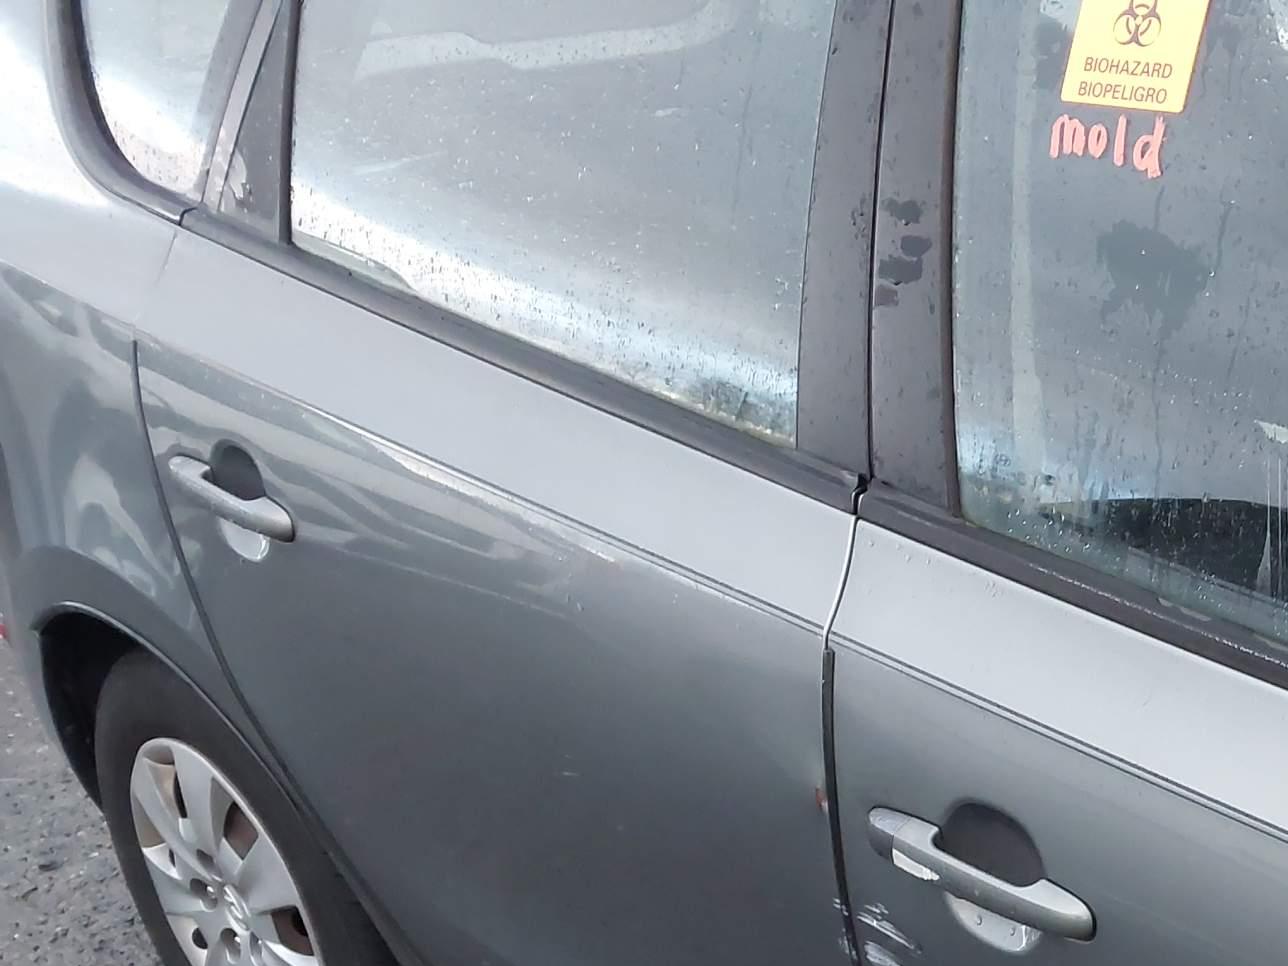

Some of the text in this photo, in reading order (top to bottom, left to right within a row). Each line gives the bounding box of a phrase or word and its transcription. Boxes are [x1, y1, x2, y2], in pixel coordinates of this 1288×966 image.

[1083, 56, 1173, 79] BIOHAZARD
[1077, 81, 1168, 104] BIOPELIGRO
[1049, 113, 1166, 179] mold
